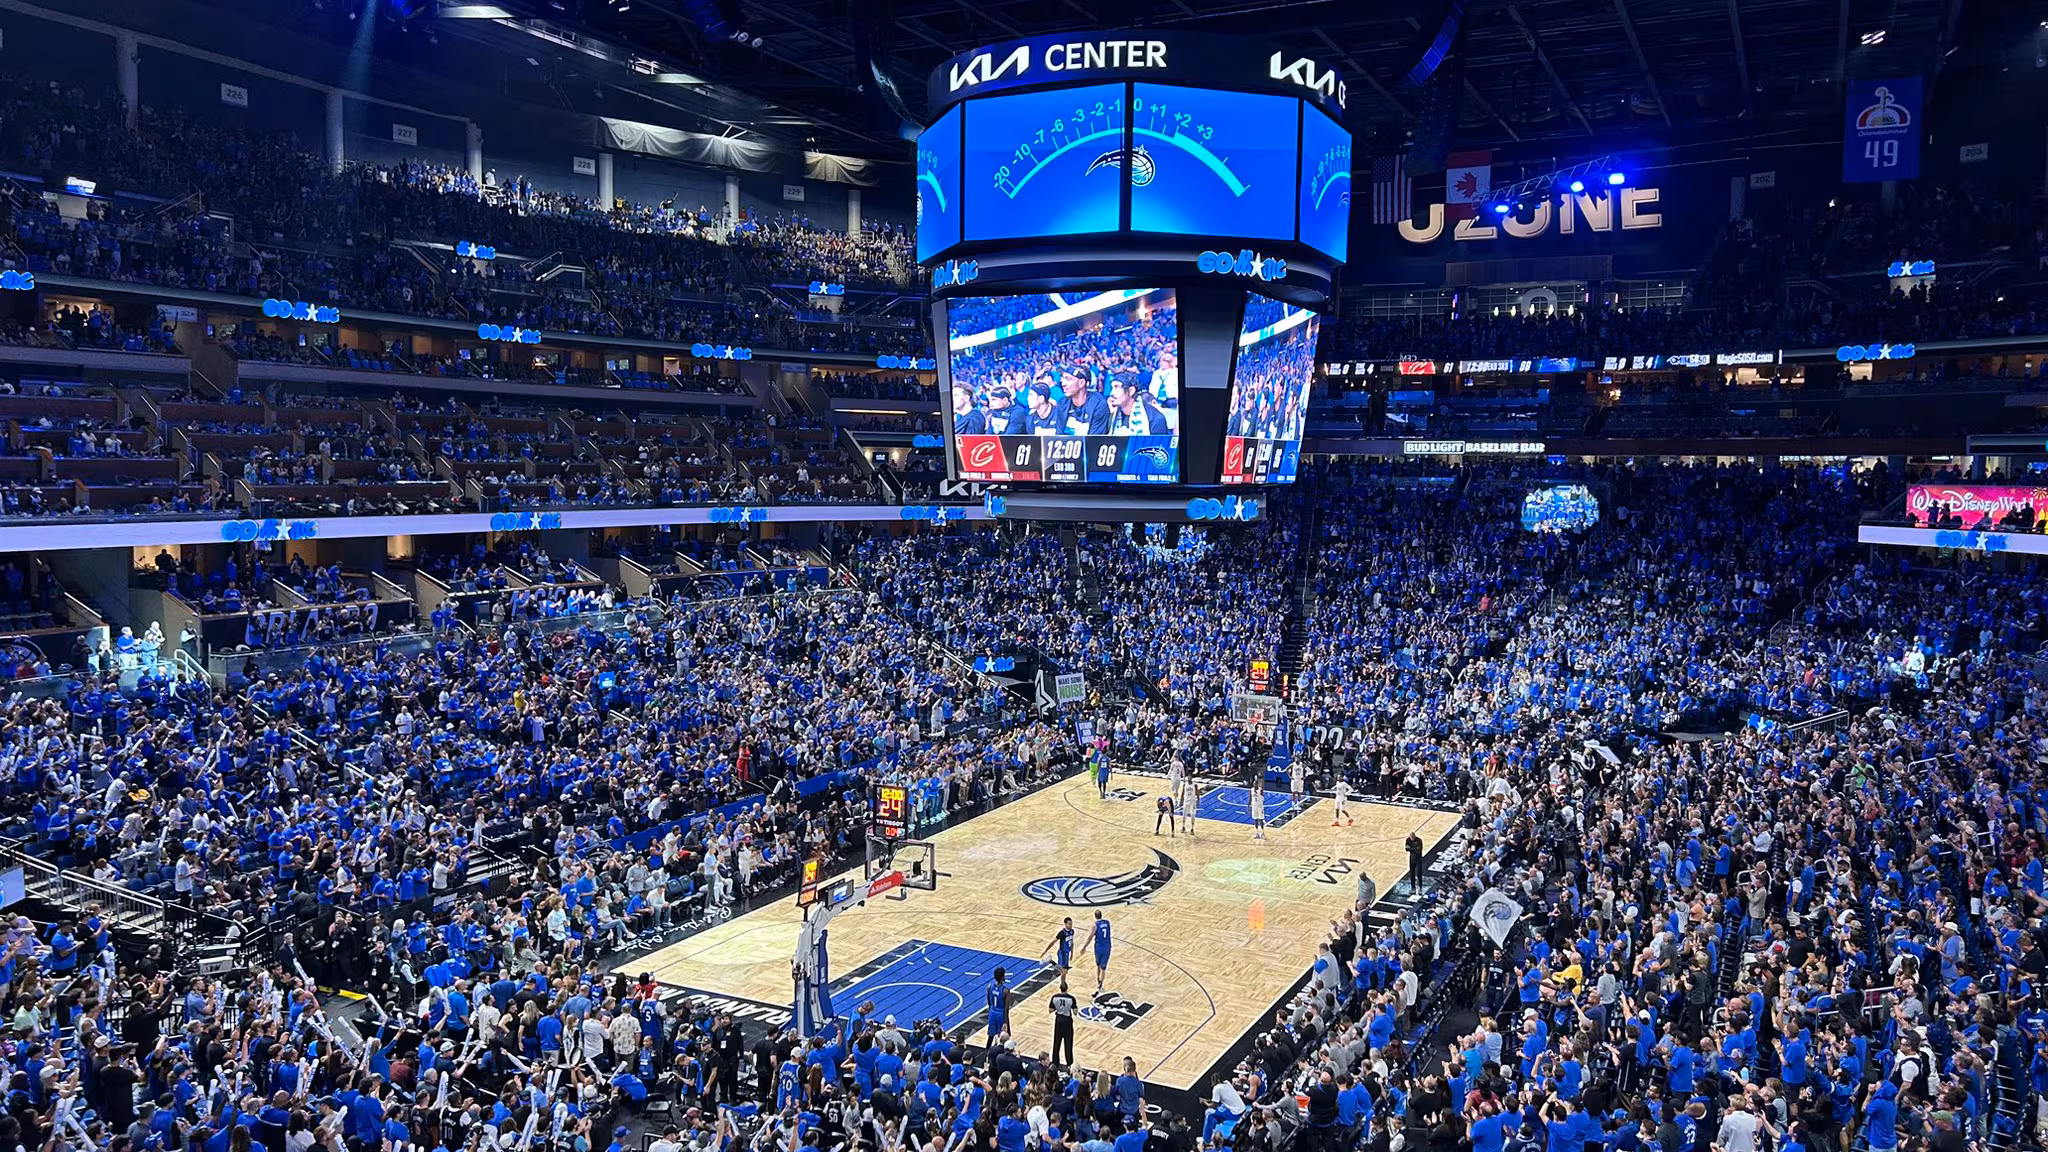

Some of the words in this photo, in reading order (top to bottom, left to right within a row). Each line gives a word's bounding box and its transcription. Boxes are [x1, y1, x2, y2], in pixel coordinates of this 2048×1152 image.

[950, 45, 1030, 92] KIA
[1045, 40, 1167, 72] CENTER
[1270, 50, 1335, 96] KIA
[226, 88, 243, 100] 226
[398, 128, 412, 138] 227
[994, 165, 1010, 189] -20
[1012, 143, 1031, 165] -10
[1033, 129, 1046, 145] -7
[1050, 118, 1064, 133] -6
[1072, 109, 1085, 123] -3
[1090, 102, 1104, 116] -2
[1108, 98, 1121, 112] -1
[1133, 97, 1143, 111] 0
[1150, 103, 1166, 118] +1
[1174, 111, 1192, 128] +2
[1197, 123, 1214, 140] +3
[1864, 139, 1899, 168] 49
[1197, 251, 1235, 274] GO
[262, 298, 293, 319] GO
[478, 323, 500, 341] GO
[1836, 345, 1866, 362] GO
[1015, 444, 1032, 466] 61
[1046, 440, 1082, 459] 12:00
[1096, 445, 1117, 467] 96
[1406, 442, 1431, 452] BUD
[1431, 442, 1463, 453] LIGHT
[1465, 442, 1520, 453] BASELINE
[1520, 442, 1546, 453] BAR
[709, 507, 731, 523] GO
[900, 505, 925, 520] GO
[1185, 497, 1221, 520] GO
[221, 519, 259, 542] GO
[490, 512, 517, 531] GO
[1935, 529, 1963, 548] GO
[1058, 684, 1085, 700] NOISE
[880, 799, 902, 819] 24
[1102, 928, 1107, 938] 7
[993, 995, 998, 1007] 1
[2035, 987, 2041, 998] 5
[645, 1010, 652, 1022] 5
[782, 1079, 793, 1091] 10
[828, 1112, 839, 1123] 50
